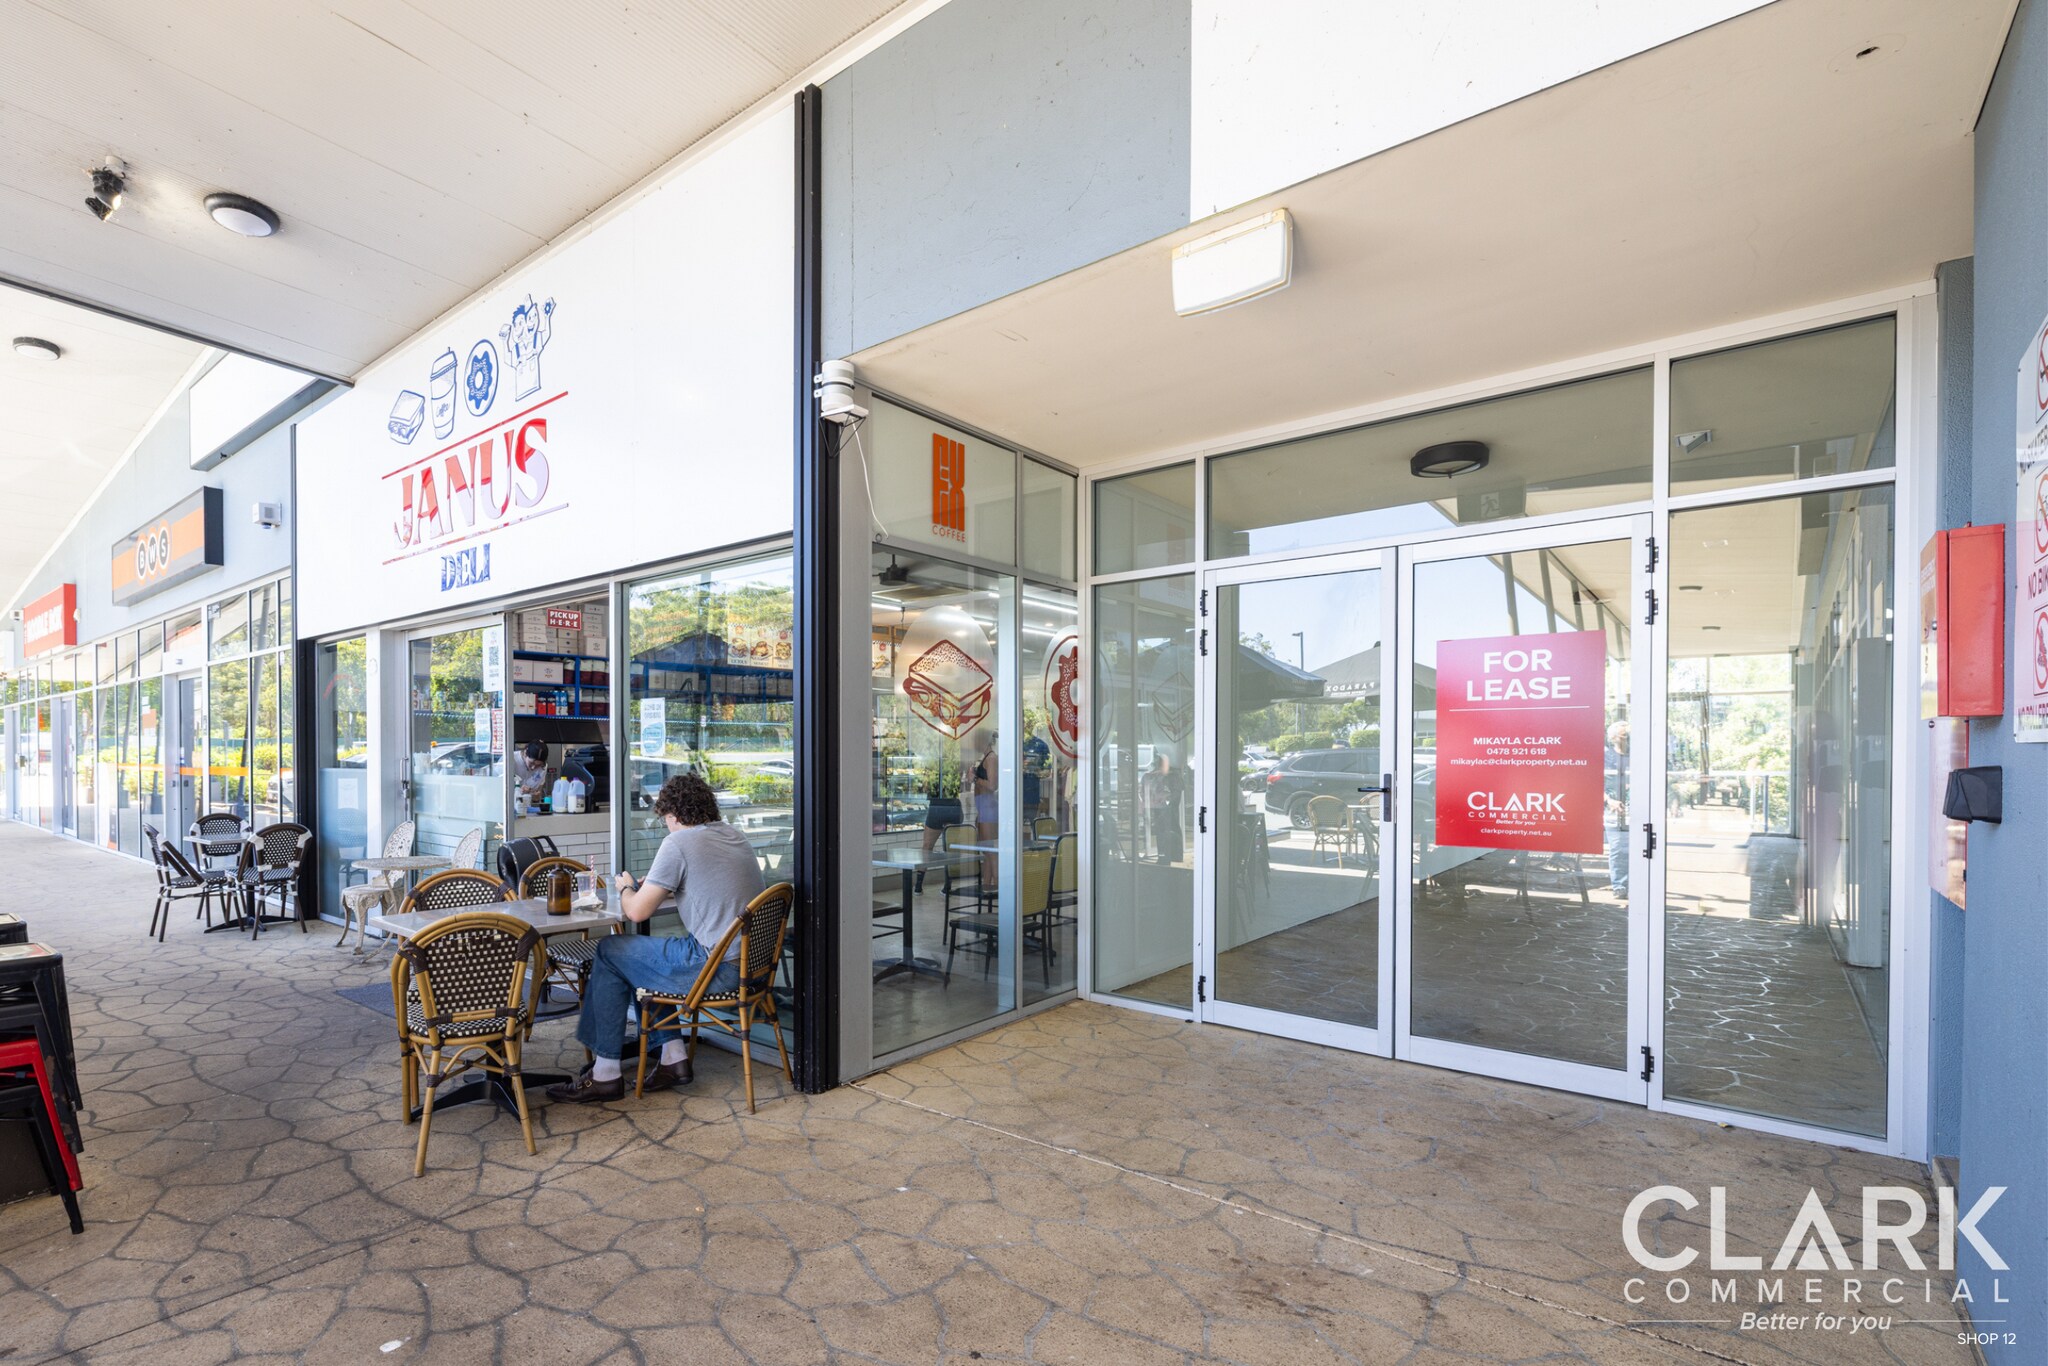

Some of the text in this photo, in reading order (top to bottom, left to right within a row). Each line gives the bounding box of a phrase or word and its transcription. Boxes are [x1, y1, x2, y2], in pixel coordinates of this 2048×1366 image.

[394, 418, 549, 549] JANUS
[932, 525, 965, 543] COFFEE
[138, 537, 167, 571] BWS
[440, 542, 491, 592] DELI
[2028, 572, 2037, 600] NO
[550, 611, 568, 619] PICK
[1484, 648, 1552, 673] FOR
[1466, 676, 1571, 702] LEASE
[1473, 736, 1562, 745] MIKAYLA CLARK
[1486, 747, 1547, 755] 0478 921 618
[1450, 757, 1587, 767] mikaylac@clarkproperty.net.au
[1467, 791, 1566, 813] CLARK
[1468, 811, 1566, 821] COMMERCIAL
[1480, 827, 1552, 836] clarkproperty.net.au
